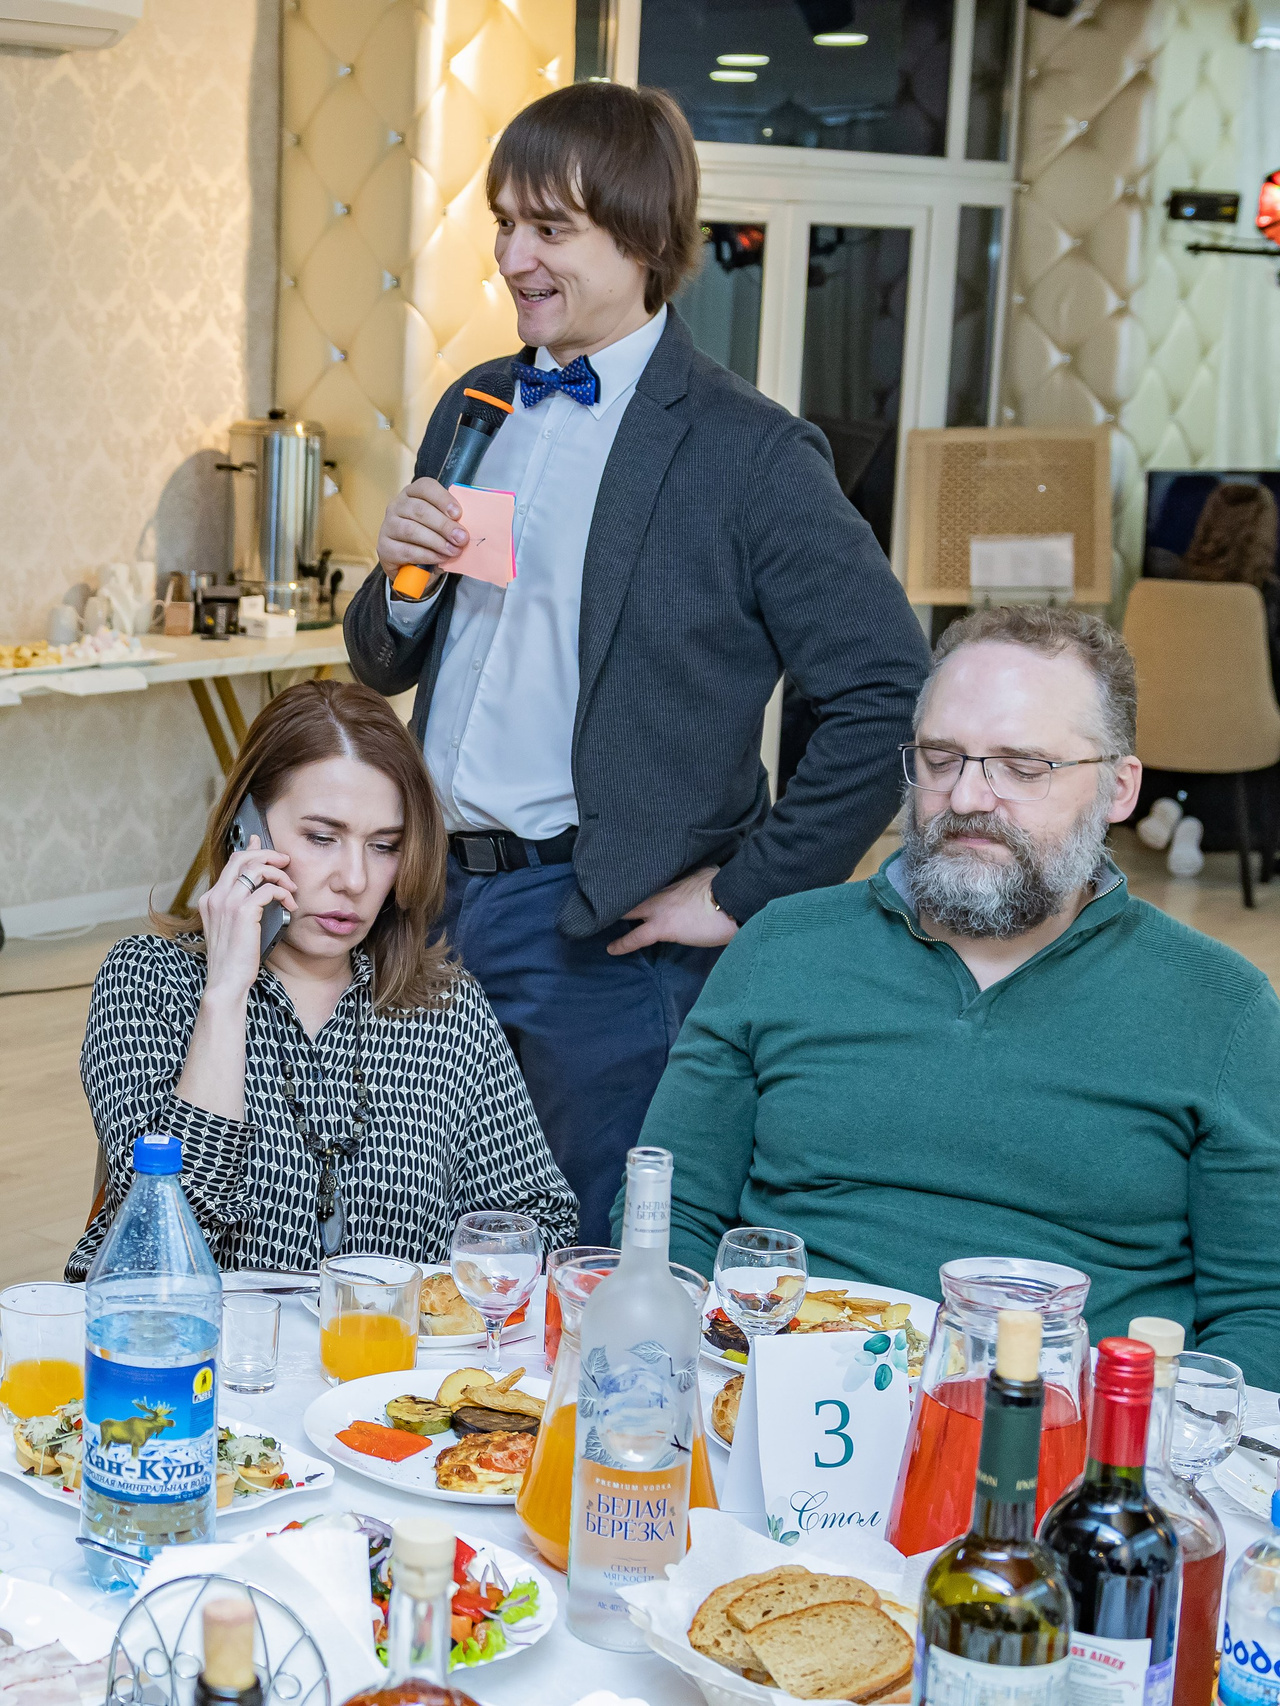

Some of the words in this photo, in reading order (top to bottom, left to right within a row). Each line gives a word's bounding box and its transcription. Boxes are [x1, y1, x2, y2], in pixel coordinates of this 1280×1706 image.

[814, 1399, 854, 1469] 3
[117, 1480, 189, 1494] МИНЕРАЛЬНАЯ
[595, 1477, 639, 1491] PREMIUM
[642, 1483, 672, 1491] VODKA
[597, 1493, 668, 1520] БЕЛАЯ
[789, 1490, 882, 1535] Стол
[586, 1511, 675, 1541] БЕРЁЗКА
